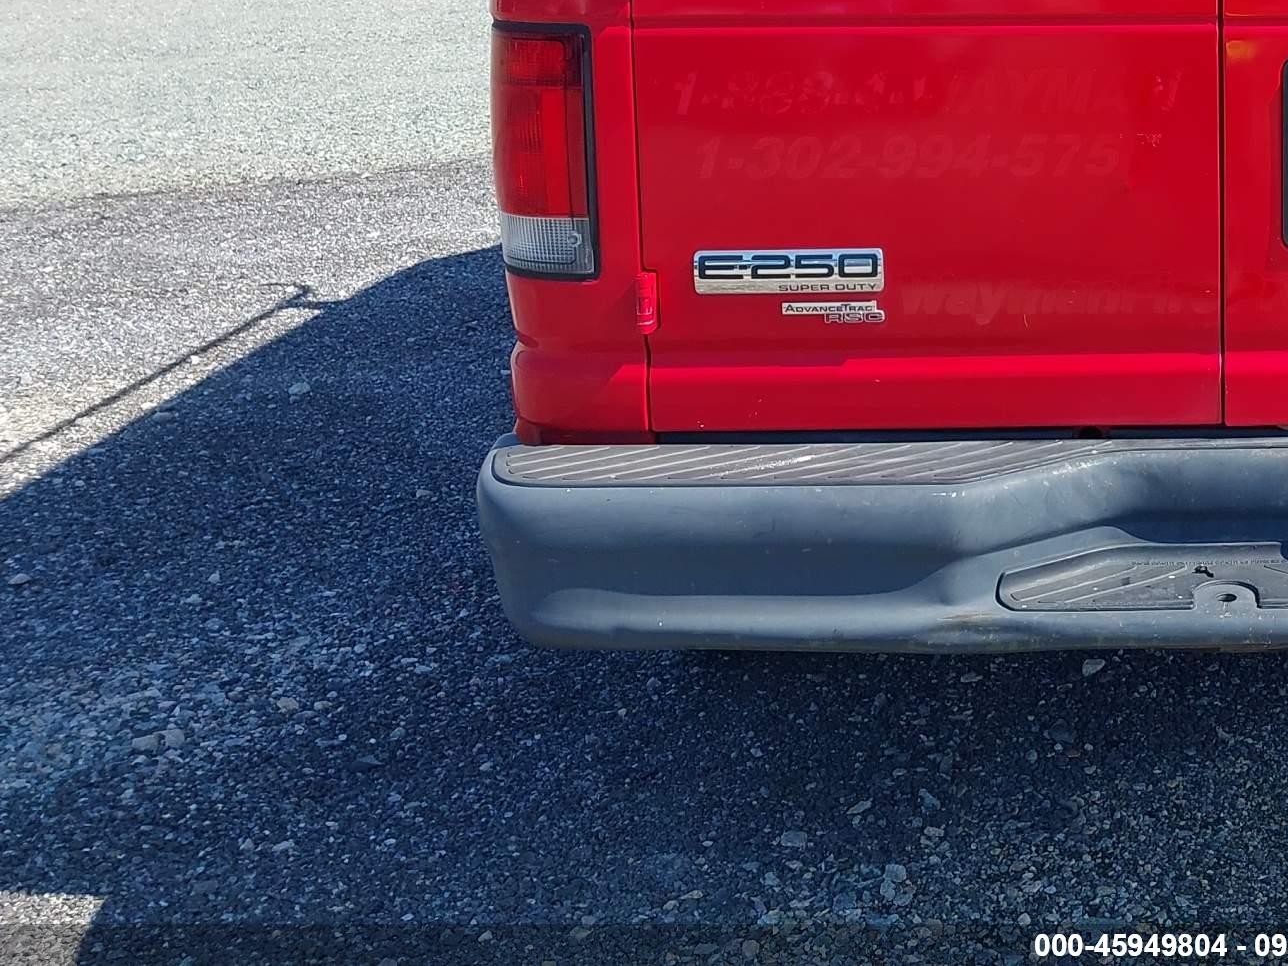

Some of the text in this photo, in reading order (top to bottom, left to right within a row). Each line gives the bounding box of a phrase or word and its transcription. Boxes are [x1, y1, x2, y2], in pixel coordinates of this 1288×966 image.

[696, 132, 1163, 180] 1-302-994-575
[698, 253, 878, 280] E-250
[778, 283, 878, 293] SUPER DUTY
[824, 312, 885, 324] RSC
